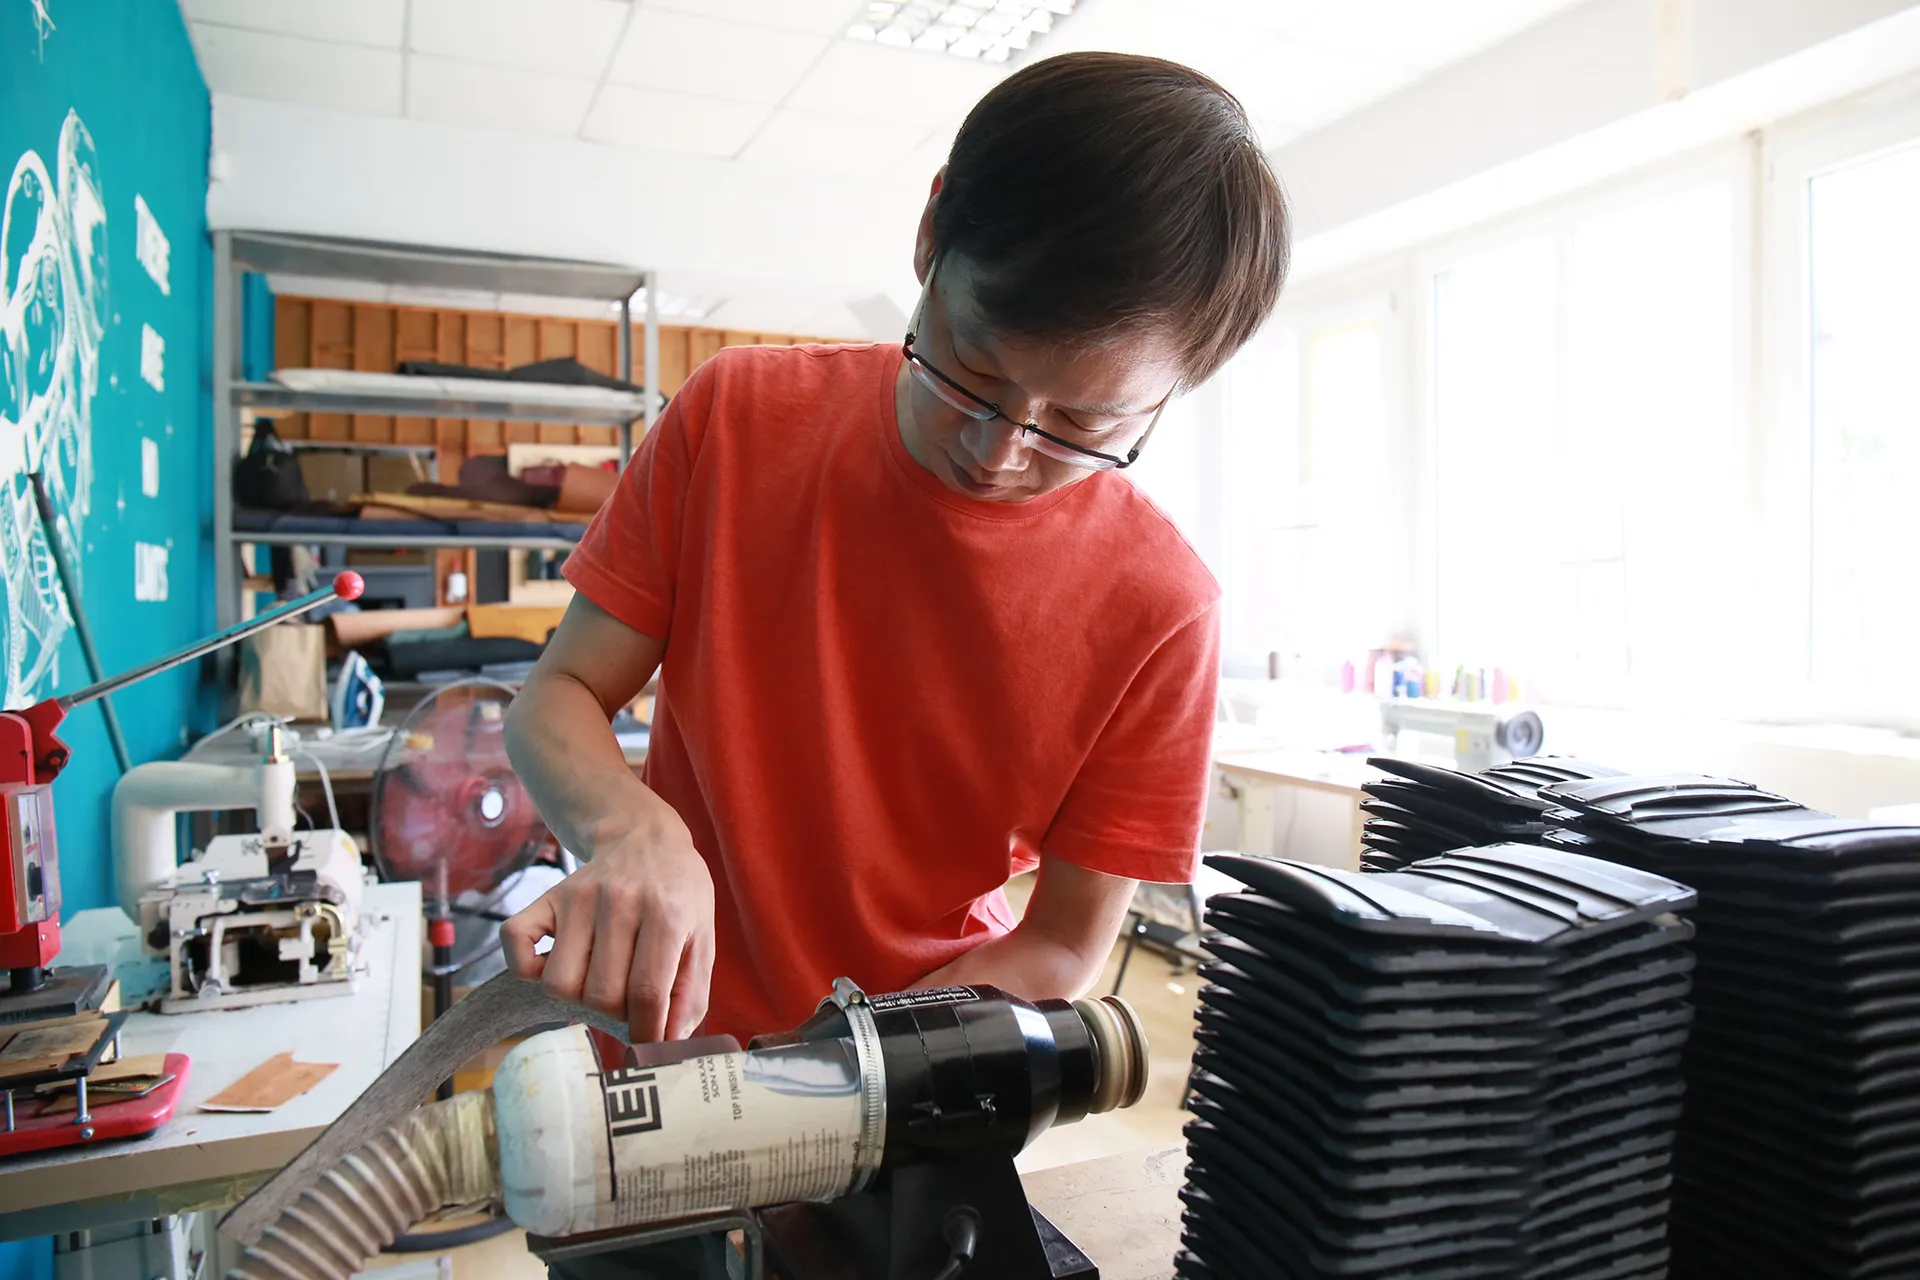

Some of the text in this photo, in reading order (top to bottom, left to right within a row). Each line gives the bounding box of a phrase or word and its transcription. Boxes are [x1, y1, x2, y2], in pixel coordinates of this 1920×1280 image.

[706, 1057, 720, 1098] SON KA
[728, 1072, 741, 1101] FINISH
[732, 1102, 743, 1120] TOP
